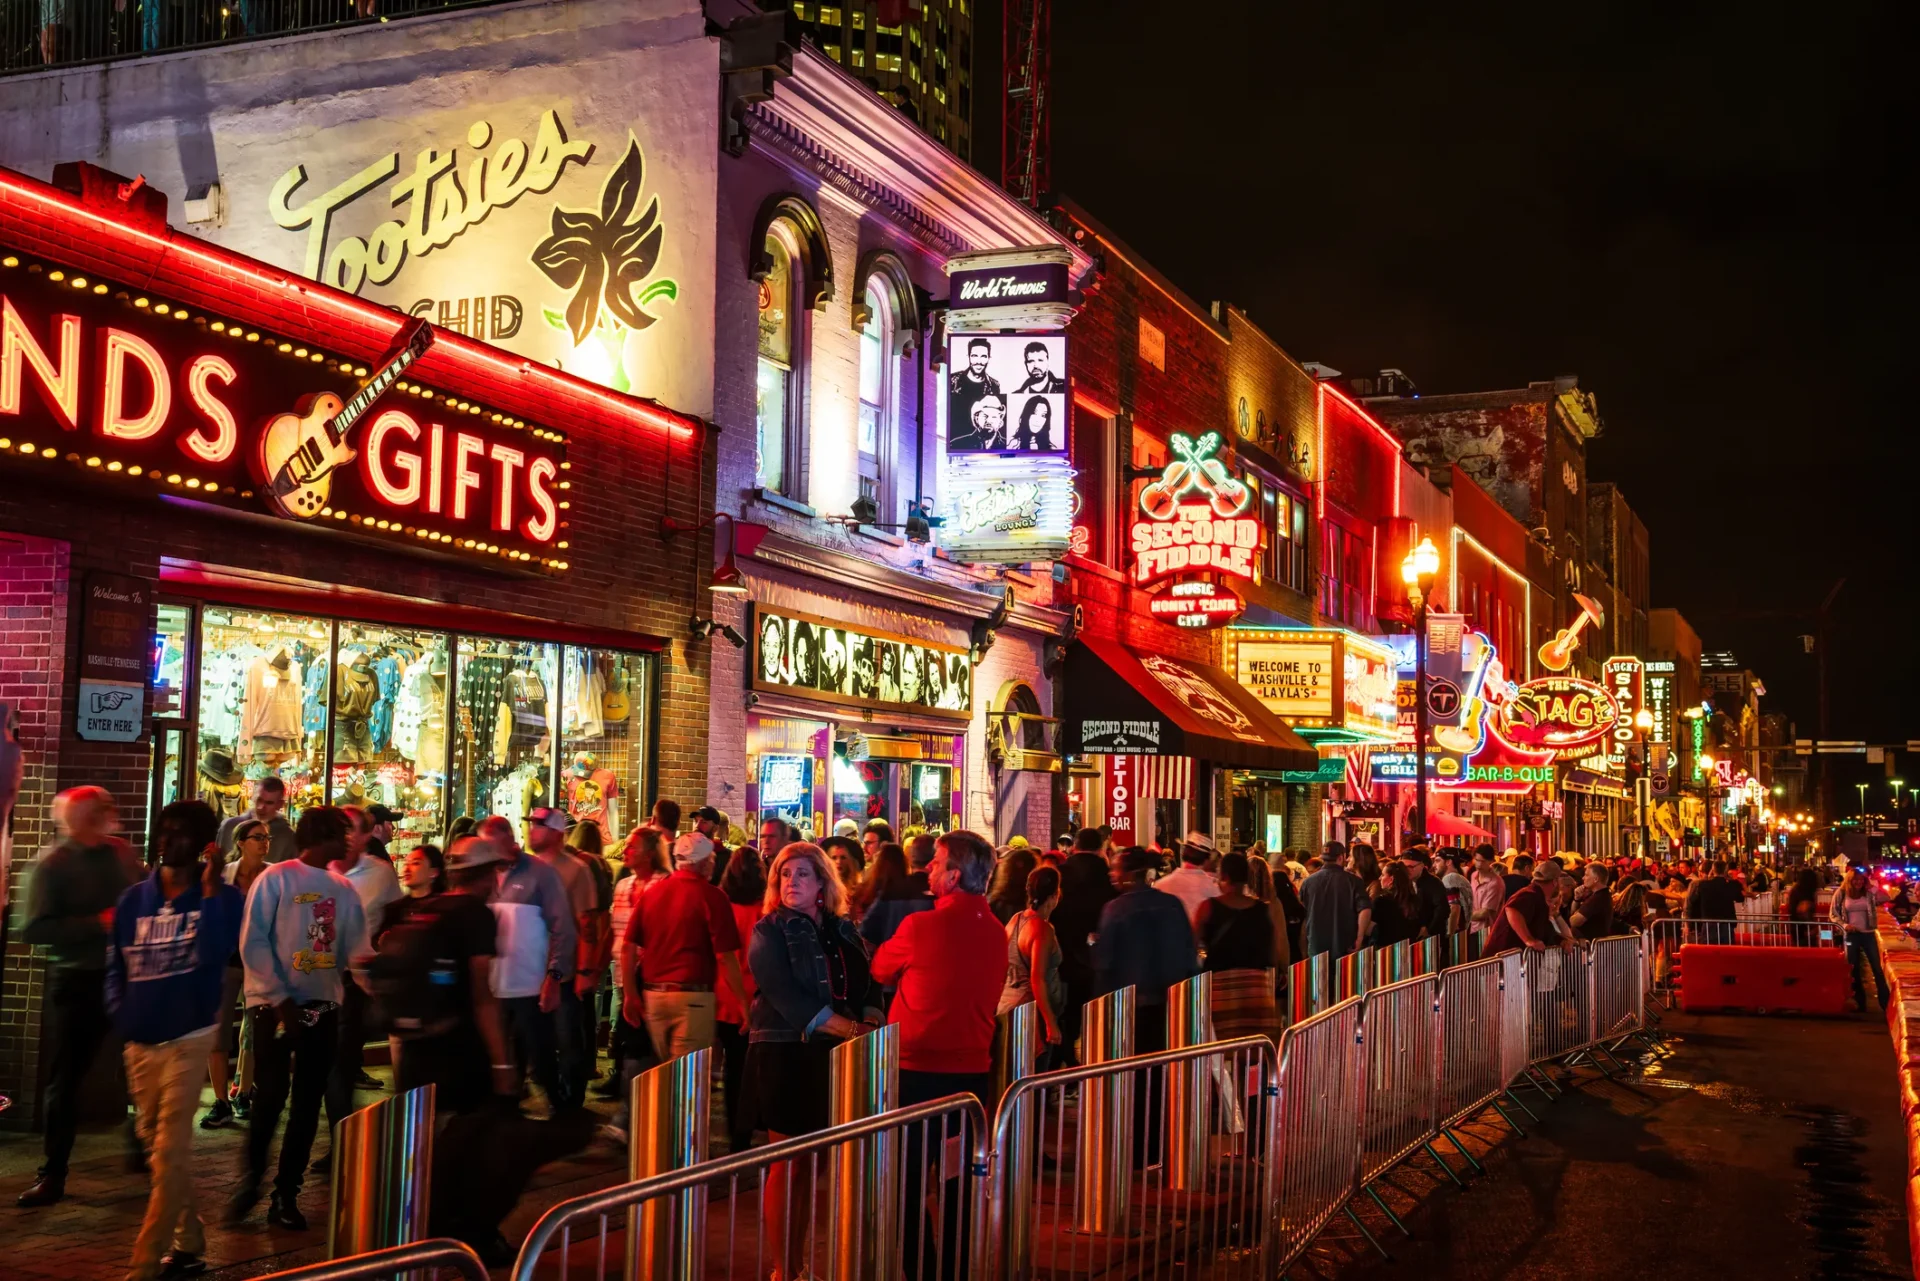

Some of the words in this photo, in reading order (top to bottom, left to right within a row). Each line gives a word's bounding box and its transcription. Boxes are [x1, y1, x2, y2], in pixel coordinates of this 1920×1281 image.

[268, 109, 595, 297] Tootsies
[960, 279, 1001, 300] World
[1001, 276, 1048, 297] Famous
[384, 294, 523, 341] HID
[367, 410, 557, 542] GIFTS
[1177, 505, 1211, 521] THE
[1132, 520, 1258, 553] SECOND
[1137, 545, 1252, 582] FIDDLE
[93, 586, 131, 602] Welcome
[1172, 584, 1215, 596] MUSIC
[1151, 600, 1195, 612] HONKY
[1199, 599, 1237, 611] TONK
[1177, 614, 1208, 627] CITY
[1430, 624, 1446, 655] HENRY
[1249, 661, 1300, 673] WELCOME
[1308, 662, 1322, 673] TO
[1606, 662, 1640, 673] LUCKY
[1251, 674, 1307, 686] NASHVILLE
[1311, 675, 1318, 686] &
[1547, 680, 1570, 691] THE
[1263, 687, 1310, 699] LAYLA'S
[1509, 687, 1616, 733] STAGE
[1650, 677, 1665, 742] WHISKE
[87, 718, 111, 731] ENTER
[114, 720, 133, 732] HERE
[1082, 720, 1120, 744] SECOND
[1122, 721, 1160, 745] FIDDLE
[1368, 745, 1389, 754] onky
[1390, 744, 1410, 752] Tonk
[1370, 754, 1404, 765] onky
[1607, 755, 1626, 764] BAST
[1467, 767, 1554, 783] BAR-B-QUE
[1113, 755, 1128, 817] FTOP
[1110, 817, 1131, 831] BAR
